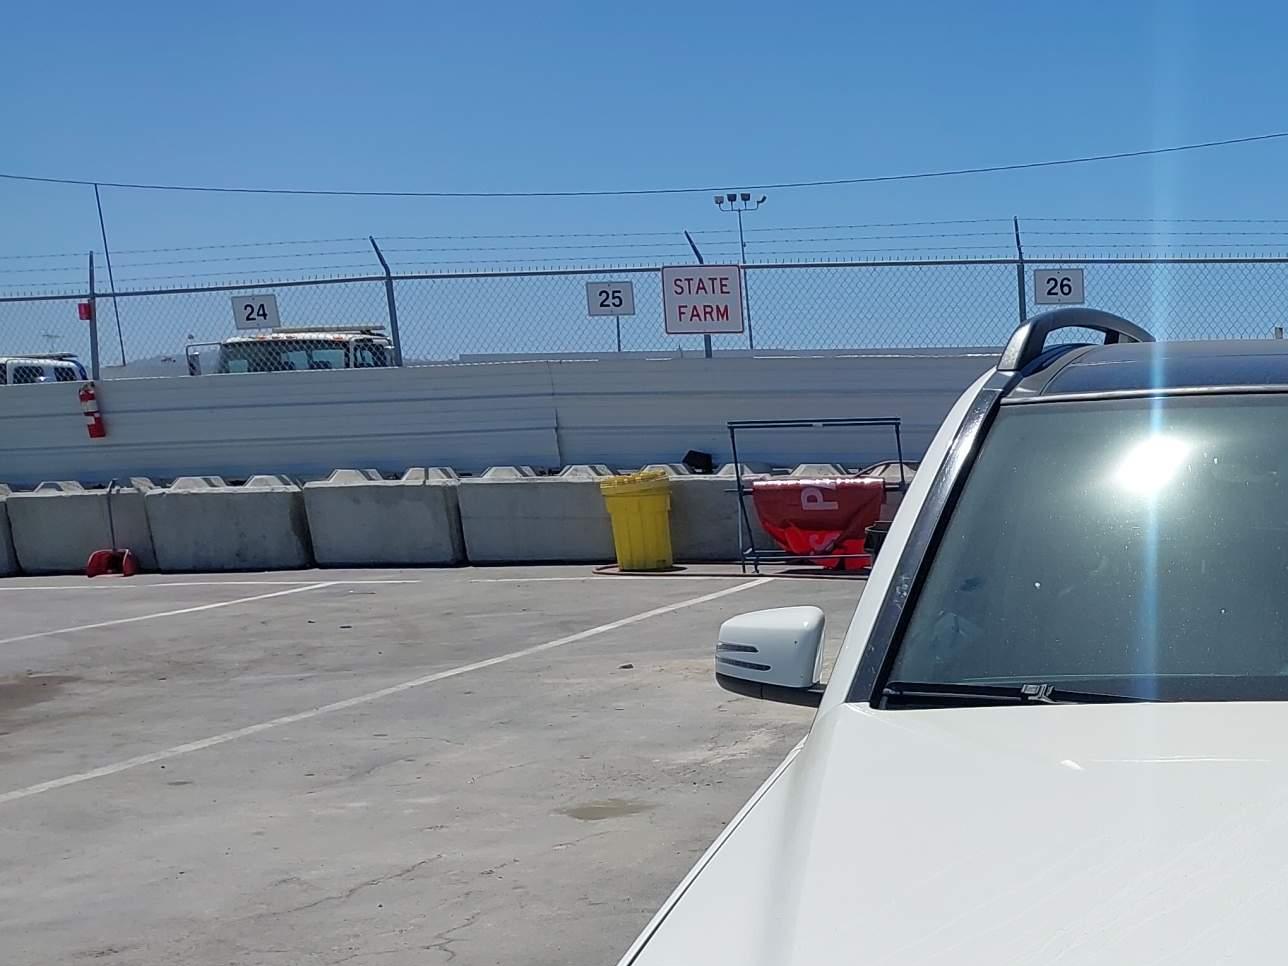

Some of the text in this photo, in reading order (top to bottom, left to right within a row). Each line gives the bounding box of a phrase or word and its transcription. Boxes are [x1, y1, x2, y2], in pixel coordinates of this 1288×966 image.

[673, 277, 731, 296] STATE
[1046, 277, 1072, 296] 26
[598, 290, 623, 308] 25
[243, 303, 268, 321] 24
[678, 304, 730, 322] FARM
